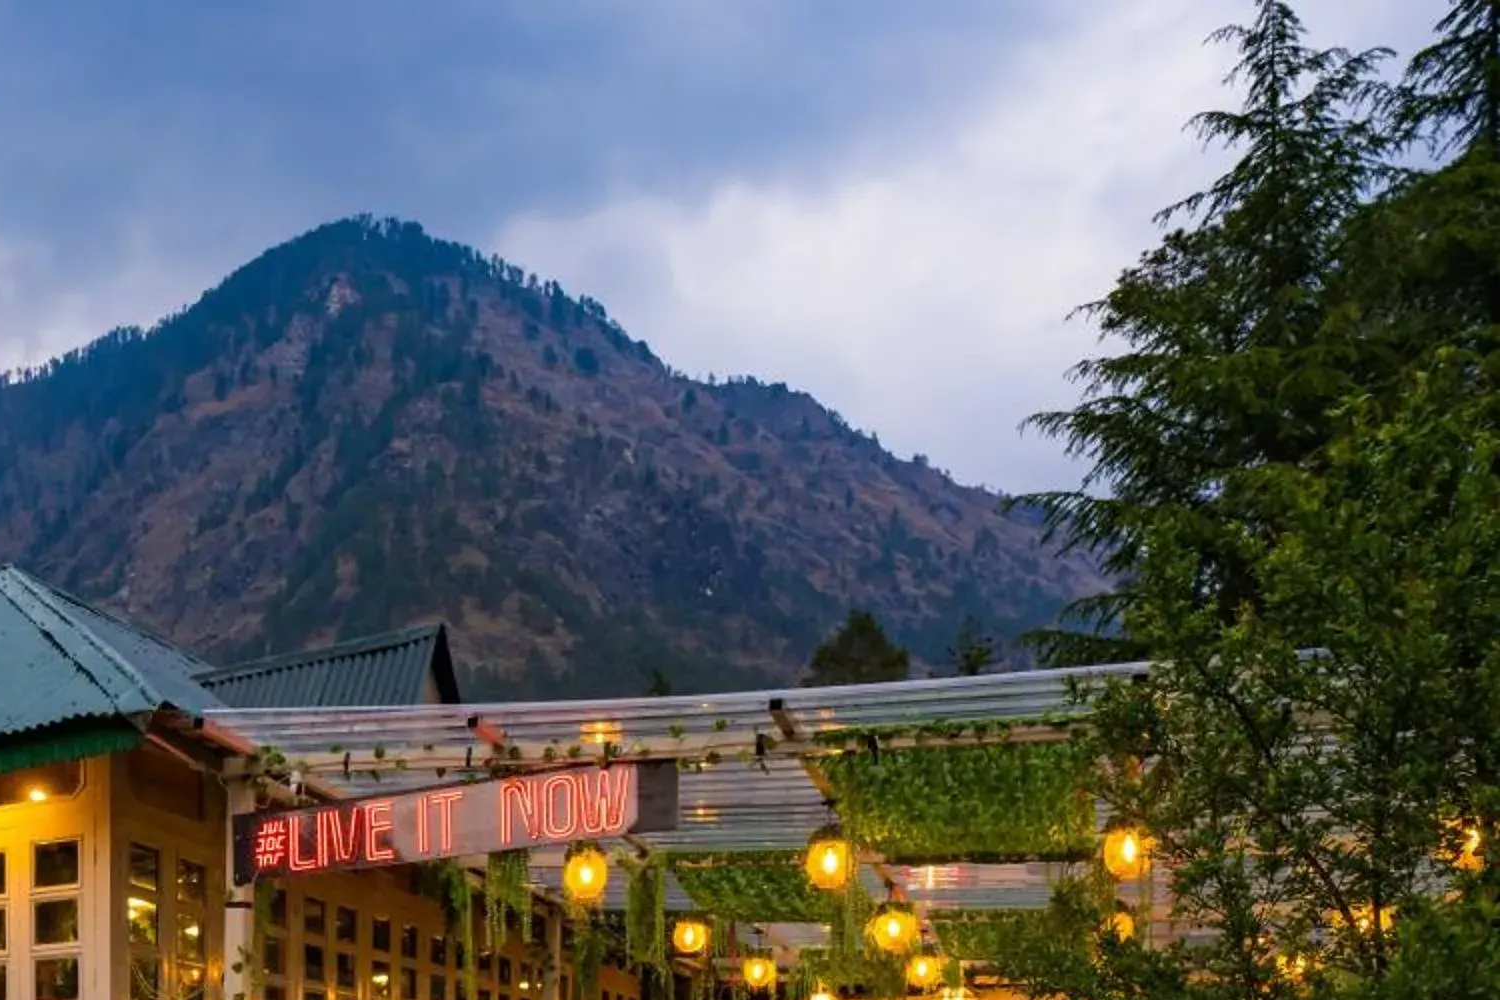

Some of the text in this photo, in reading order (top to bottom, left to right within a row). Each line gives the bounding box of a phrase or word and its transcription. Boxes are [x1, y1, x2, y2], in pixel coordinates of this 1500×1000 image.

[255, 768, 630, 872] #LIVE IT NOW
